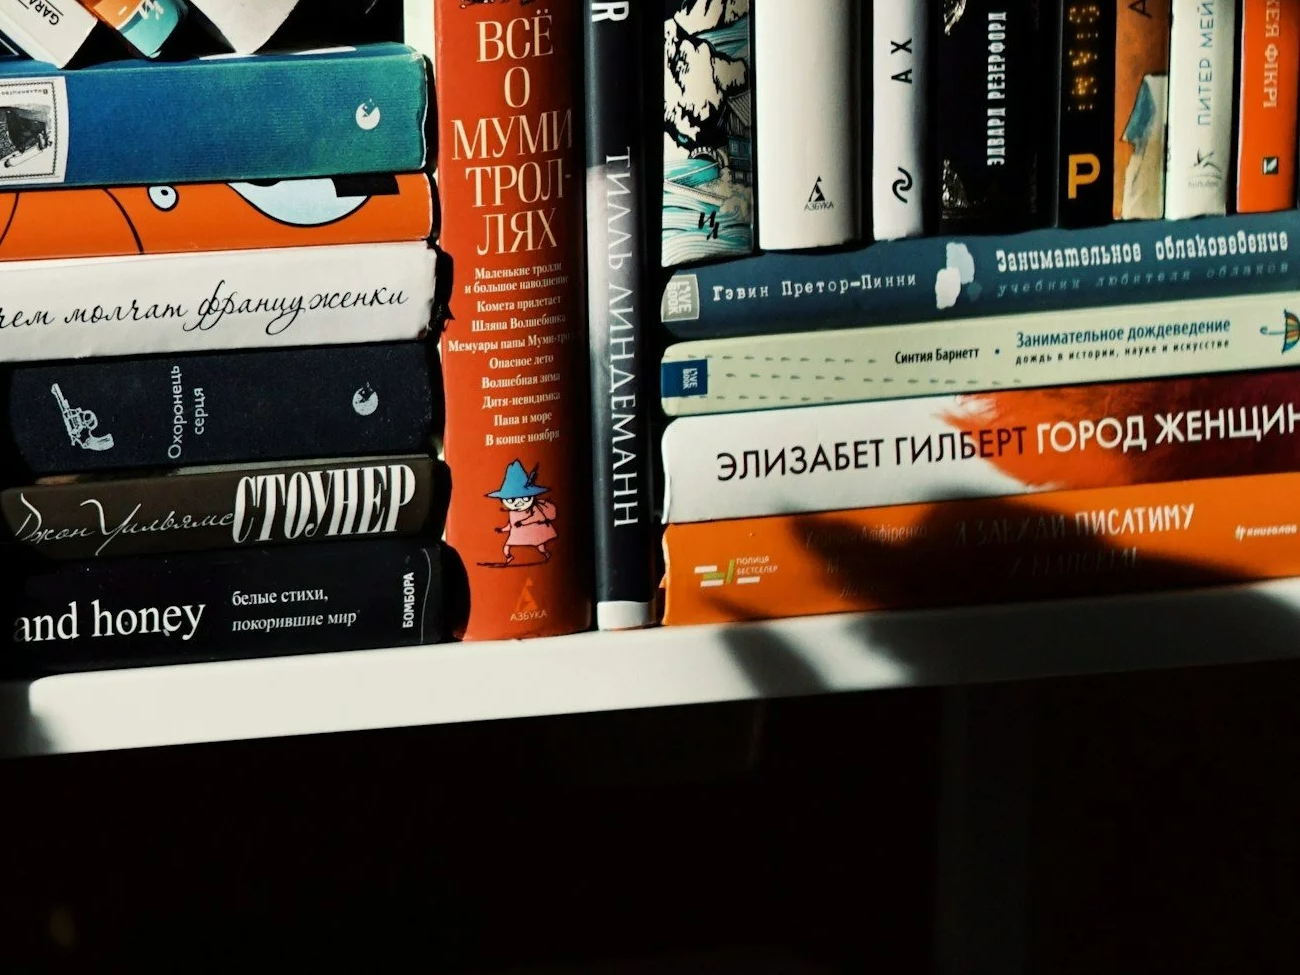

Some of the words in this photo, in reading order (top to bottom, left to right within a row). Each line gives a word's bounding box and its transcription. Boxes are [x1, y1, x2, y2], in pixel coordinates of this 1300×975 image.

[475, 9, 554, 63] ВСЁ
[503, 66, 531, 108] О
[1262, 42, 1279, 108] ФІКРІ
[452, 108, 572, 162] МУМИ
[1067, 152, 1101, 201] P
[605, 145, 633, 271] ТИЛЛЬ
[476, 209, 558, 256] ЛЯХ
[996, 242, 1142, 273] Занимательное
[1155, 230, 1289, 261] облаковедение
[473, 278, 518, 294] большое
[474, 264, 531, 281] Маленькие
[713, 284, 769, 302] Гэвин
[782, 274, 917, 297] Претор-Пинни
[63, 299, 188, 326] молчат
[183, 279, 409, 337] француженки
[476, 298, 516, 314] Комета
[676, 279, 692, 314] LIVE
[471, 318, 508, 334] Шляпа
[1016, 329, 1125, 349] Занимательное
[1127, 318, 1231, 342] дождеведение
[448, 338, 499, 355] Мемуары
[500, 337, 527, 352] папы
[489, 356, 532, 370] Опасное
[533, 352, 554, 366] лето
[895, 349, 934, 365] Синтия
[935, 346, 980, 363] Барнетт
[1015, 353, 1053, 366] дождь
[1068, 348, 1120, 362] истории,
[1124, 345, 1157, 357] науке
[1173, 338, 1230, 353] искусстве
[481, 373, 538, 389] Волшебная
[166, 364, 183, 461] Охоронець
[191, 386, 208, 438] серця
[494, 413, 521, 427] Папа
[530, 410, 553, 425] море
[608, 282, 639, 529] ЛИНДЕМАНН
[485, 433, 494, 446] В
[496, 432, 527, 447] конце
[528, 428, 560, 444] ноября
[716, 438, 885, 481] ЭЛИЗАБЕТ
[895, 426, 1026, 466] ГИЛБЕРТ
[1037, 415, 1148, 455] ГОРОД
[14, 492, 95, 543] Джон
[231, 464, 417, 544] СТОУНЕР
[1075, 503, 1196, 538] ПИСАТИМУ
[231, 589, 278, 608] белые
[280, 587, 330, 605] стихи,
[401, 570, 415, 630] БОМБОРА
[509, 608, 548, 623] АЗБУКА
[12, 600, 78, 643] and
[91, 596, 207, 647] honey
[231, 612, 324, 635] покорившие
[327, 609, 357, 631] мир
